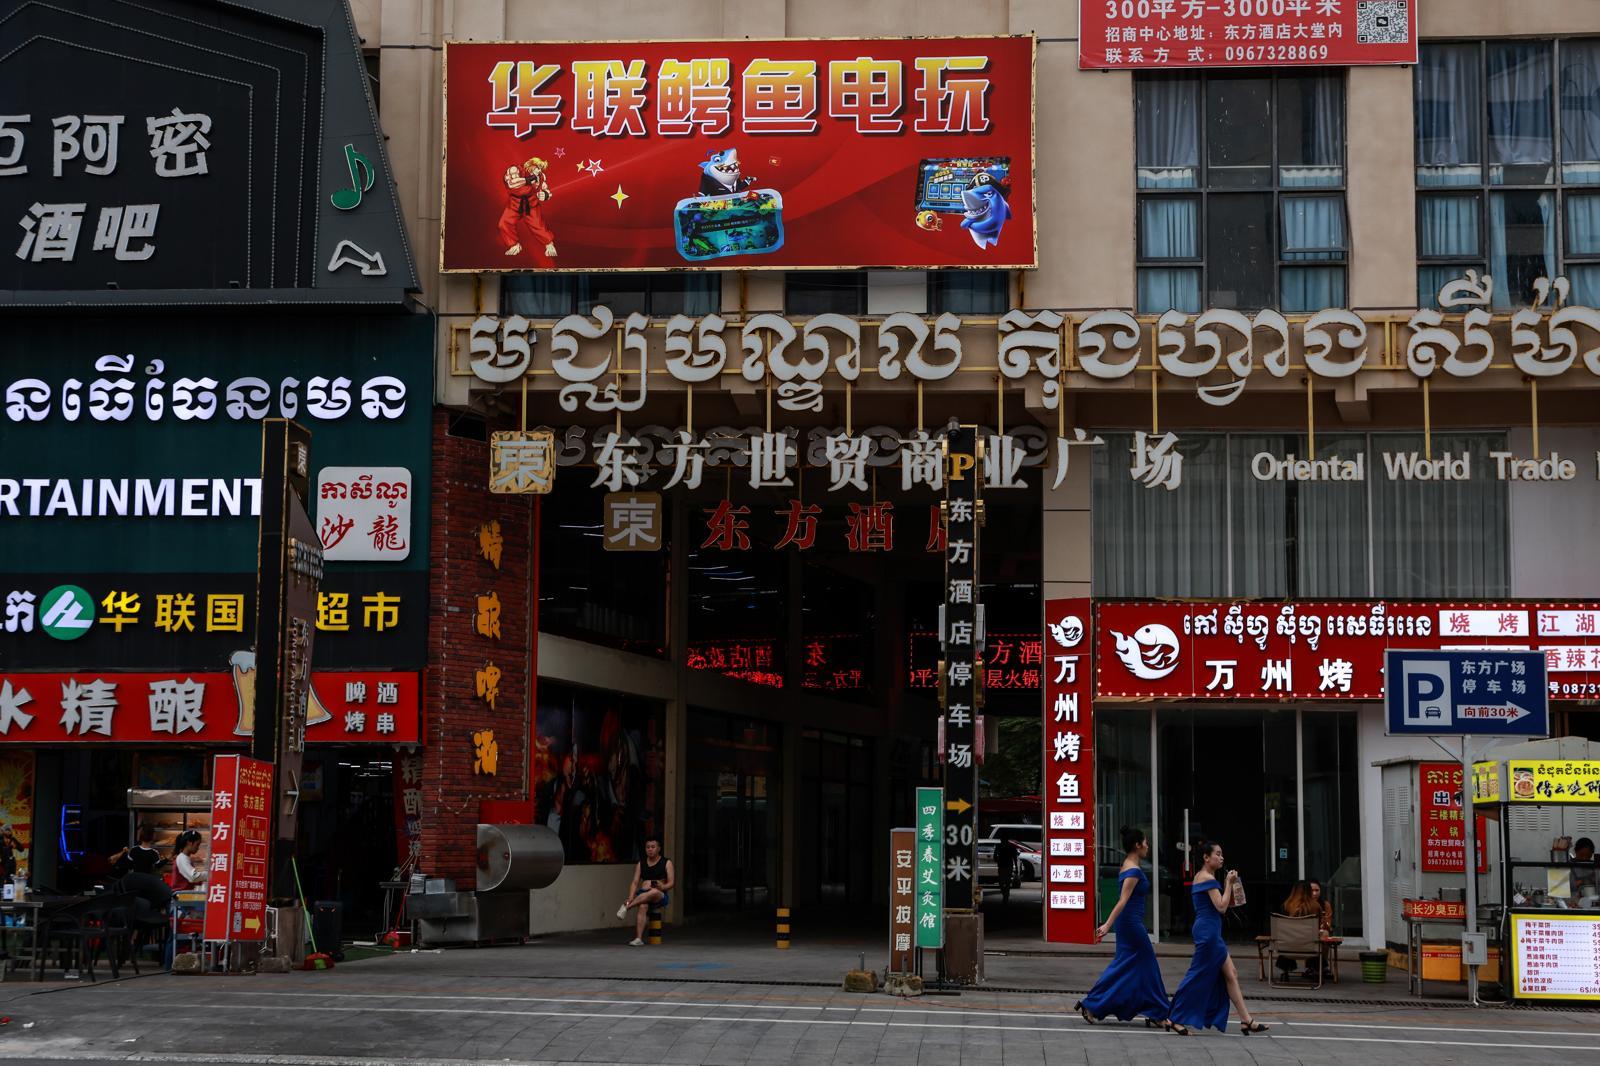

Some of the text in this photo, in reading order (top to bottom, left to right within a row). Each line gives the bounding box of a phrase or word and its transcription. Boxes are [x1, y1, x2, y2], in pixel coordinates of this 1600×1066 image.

[486, 55, 990, 137] 华联鳄鱼电玩
[15, 202, 161, 262] 酒吧
[591, 428, 1183, 491] 东方世贸商业广场
[949, 453, 975, 480] P
[1250, 451, 1576, 482] Oriental World Trade
[321, 514, 406, 551] 沙龍
[100, 590, 401, 633] 华联国超市
[1449, 612, 1519, 633] 烧烤
[1541, 614, 1595, 633] 江湖
[948, 497, 972, 768] 东方酒店停车场
[1206, 658, 1384, 692] 万州烤
[1461, 660, 1526, 675] 东方广场
[346, 681, 398, 703] 啤酒
[1408, 673, 1444, 718] P
[1462, 680, 1527, 694] 停车场
[345, 711, 396, 734] 烤串
[1464, 707, 1519, 718] 向前30米
[1054, 656, 1081, 803] 万州烤鱼
[1054, 814, 1080, 827] 烧烤
[208, 790, 232, 904] 东方酒店
[947, 825, 972, 882] 30米
[1052, 842, 1083, 852] 江湖菜
[920, 805, 938, 929] 四季春艾灸馆
[1052, 868, 1083, 879] 小龙虾
[1052, 894, 1084, 905] 香辣花甲
